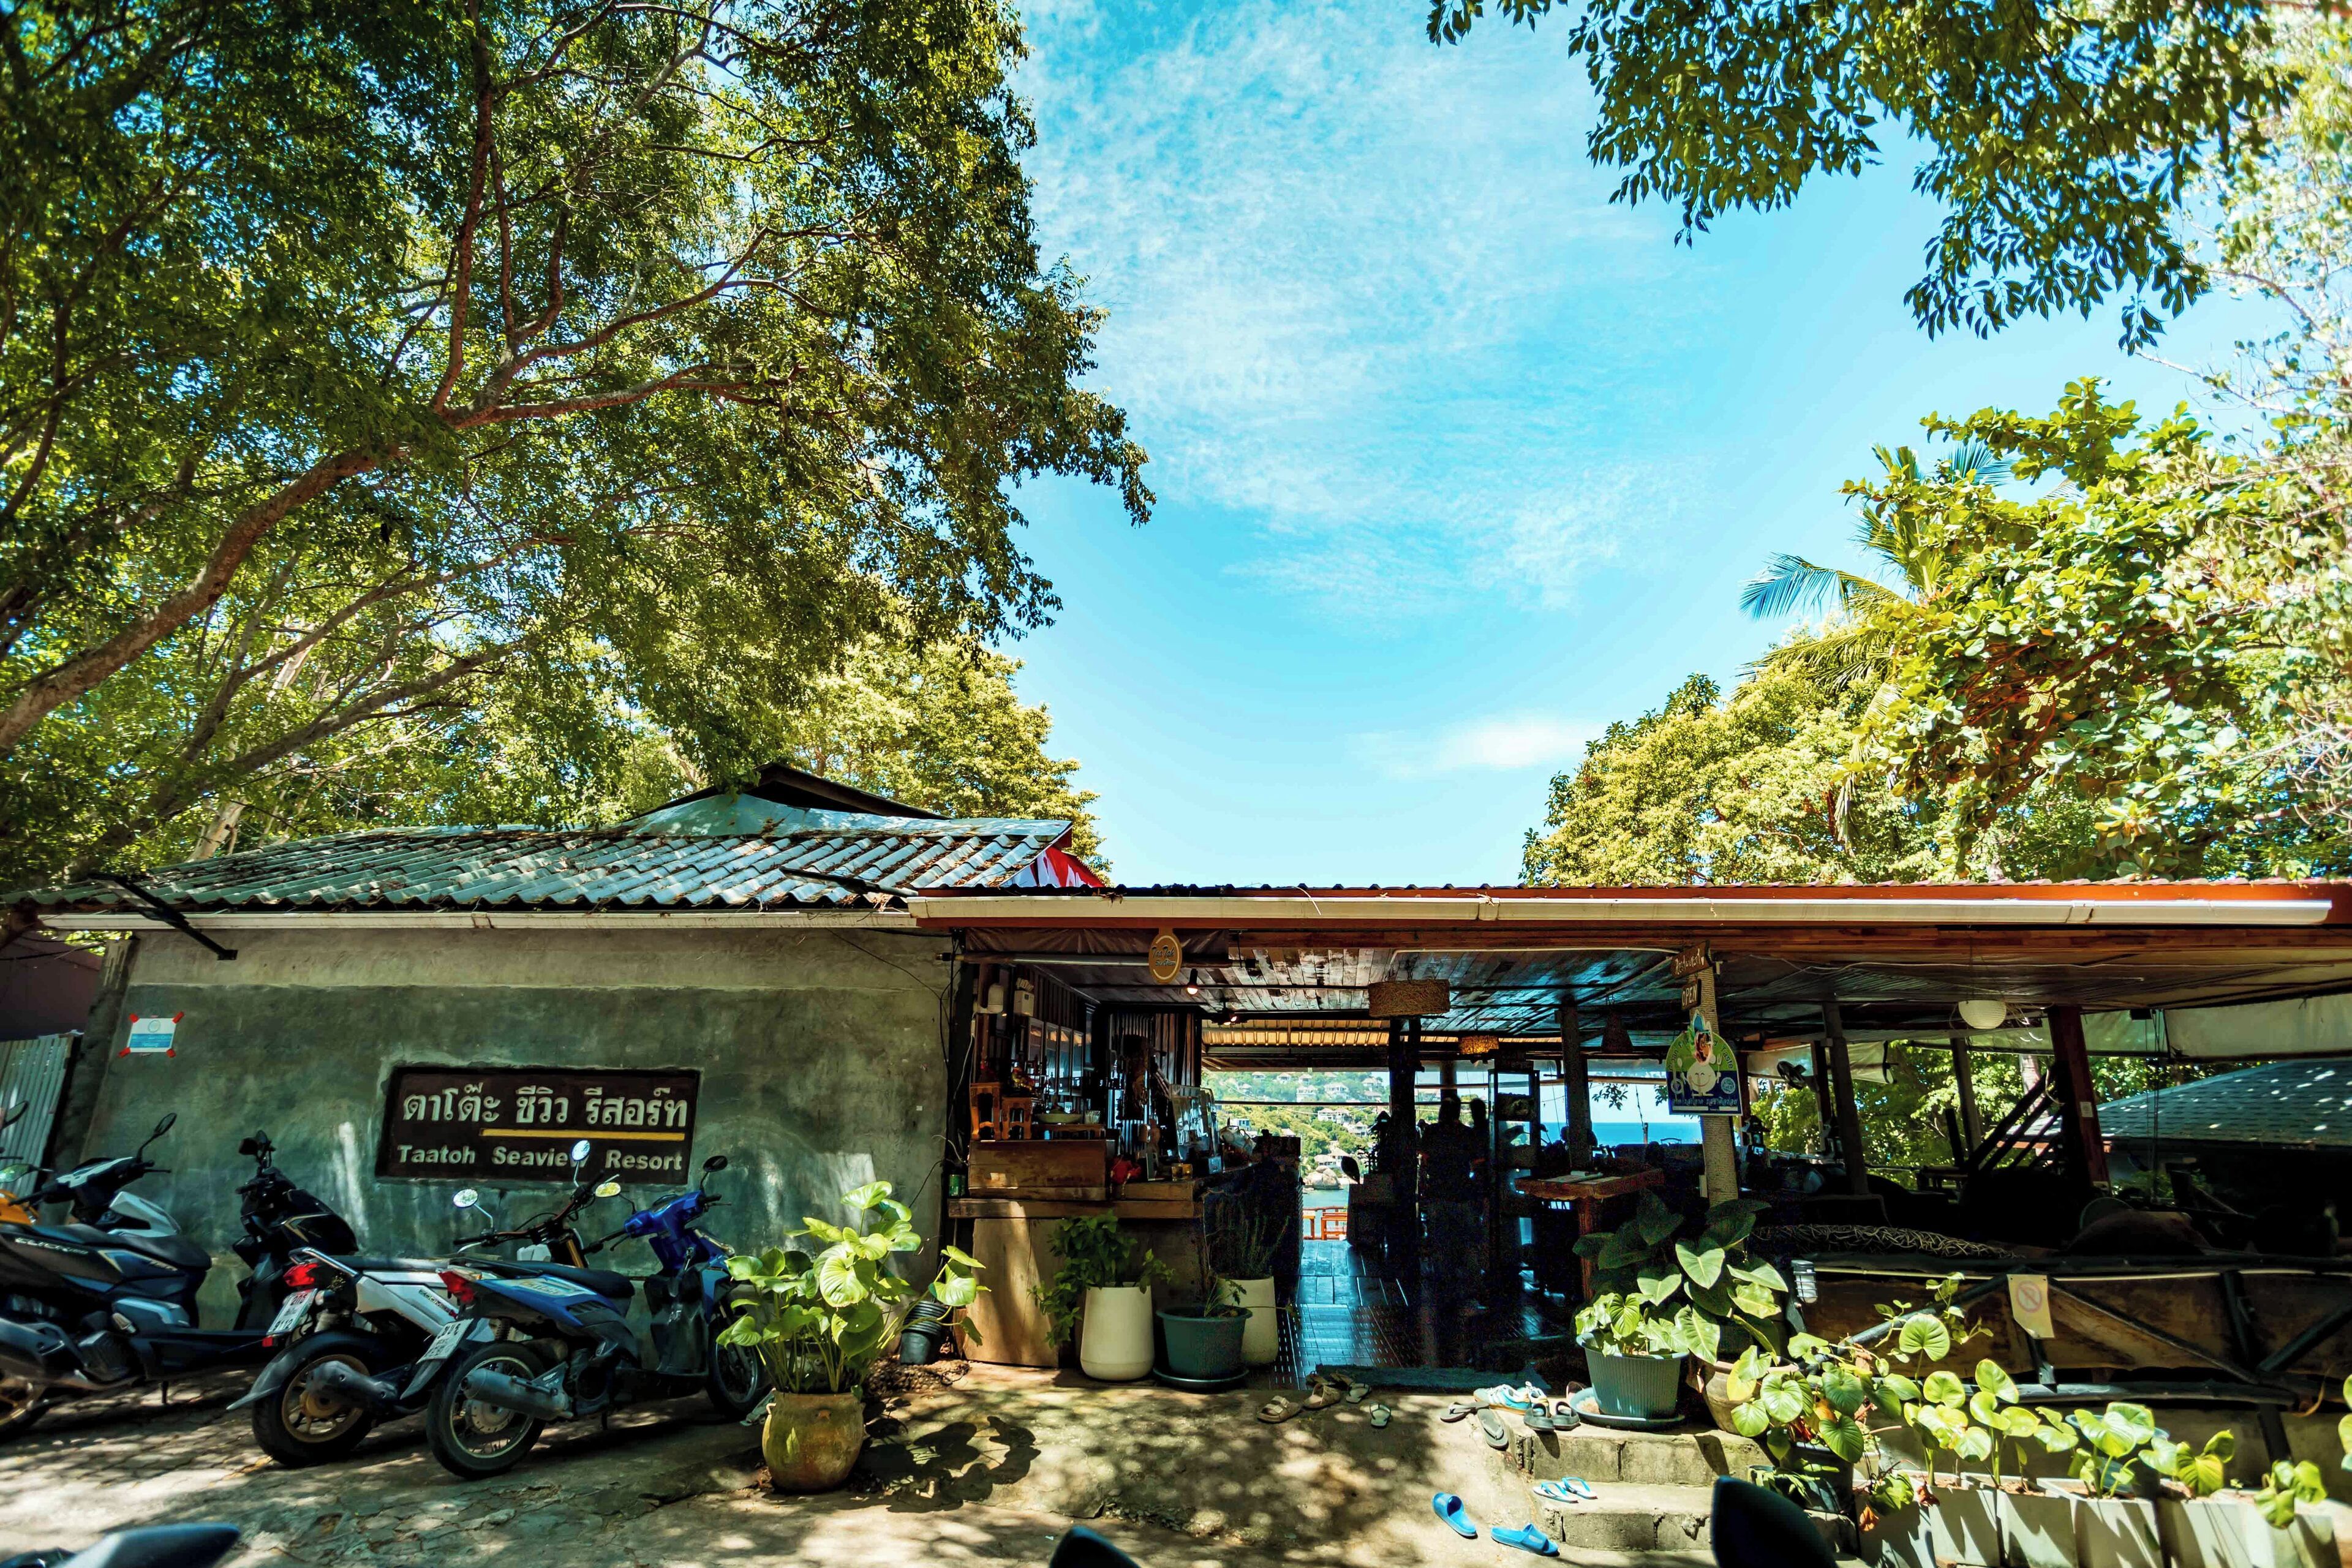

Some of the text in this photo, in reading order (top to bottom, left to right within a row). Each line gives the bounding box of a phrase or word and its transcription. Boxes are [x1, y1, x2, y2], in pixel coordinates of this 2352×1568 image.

[1681, 983, 1697, 1006] OPEN
[1721, 1045, 1733, 1069] Taste
[402, 1082, 500, 1122] ตาโต๊ะ
[584, 1087, 687, 1127] รีสอร์ท
[398, 1144, 475, 1163] Taatoh
[605, 1149, 682, 1170] Resort
